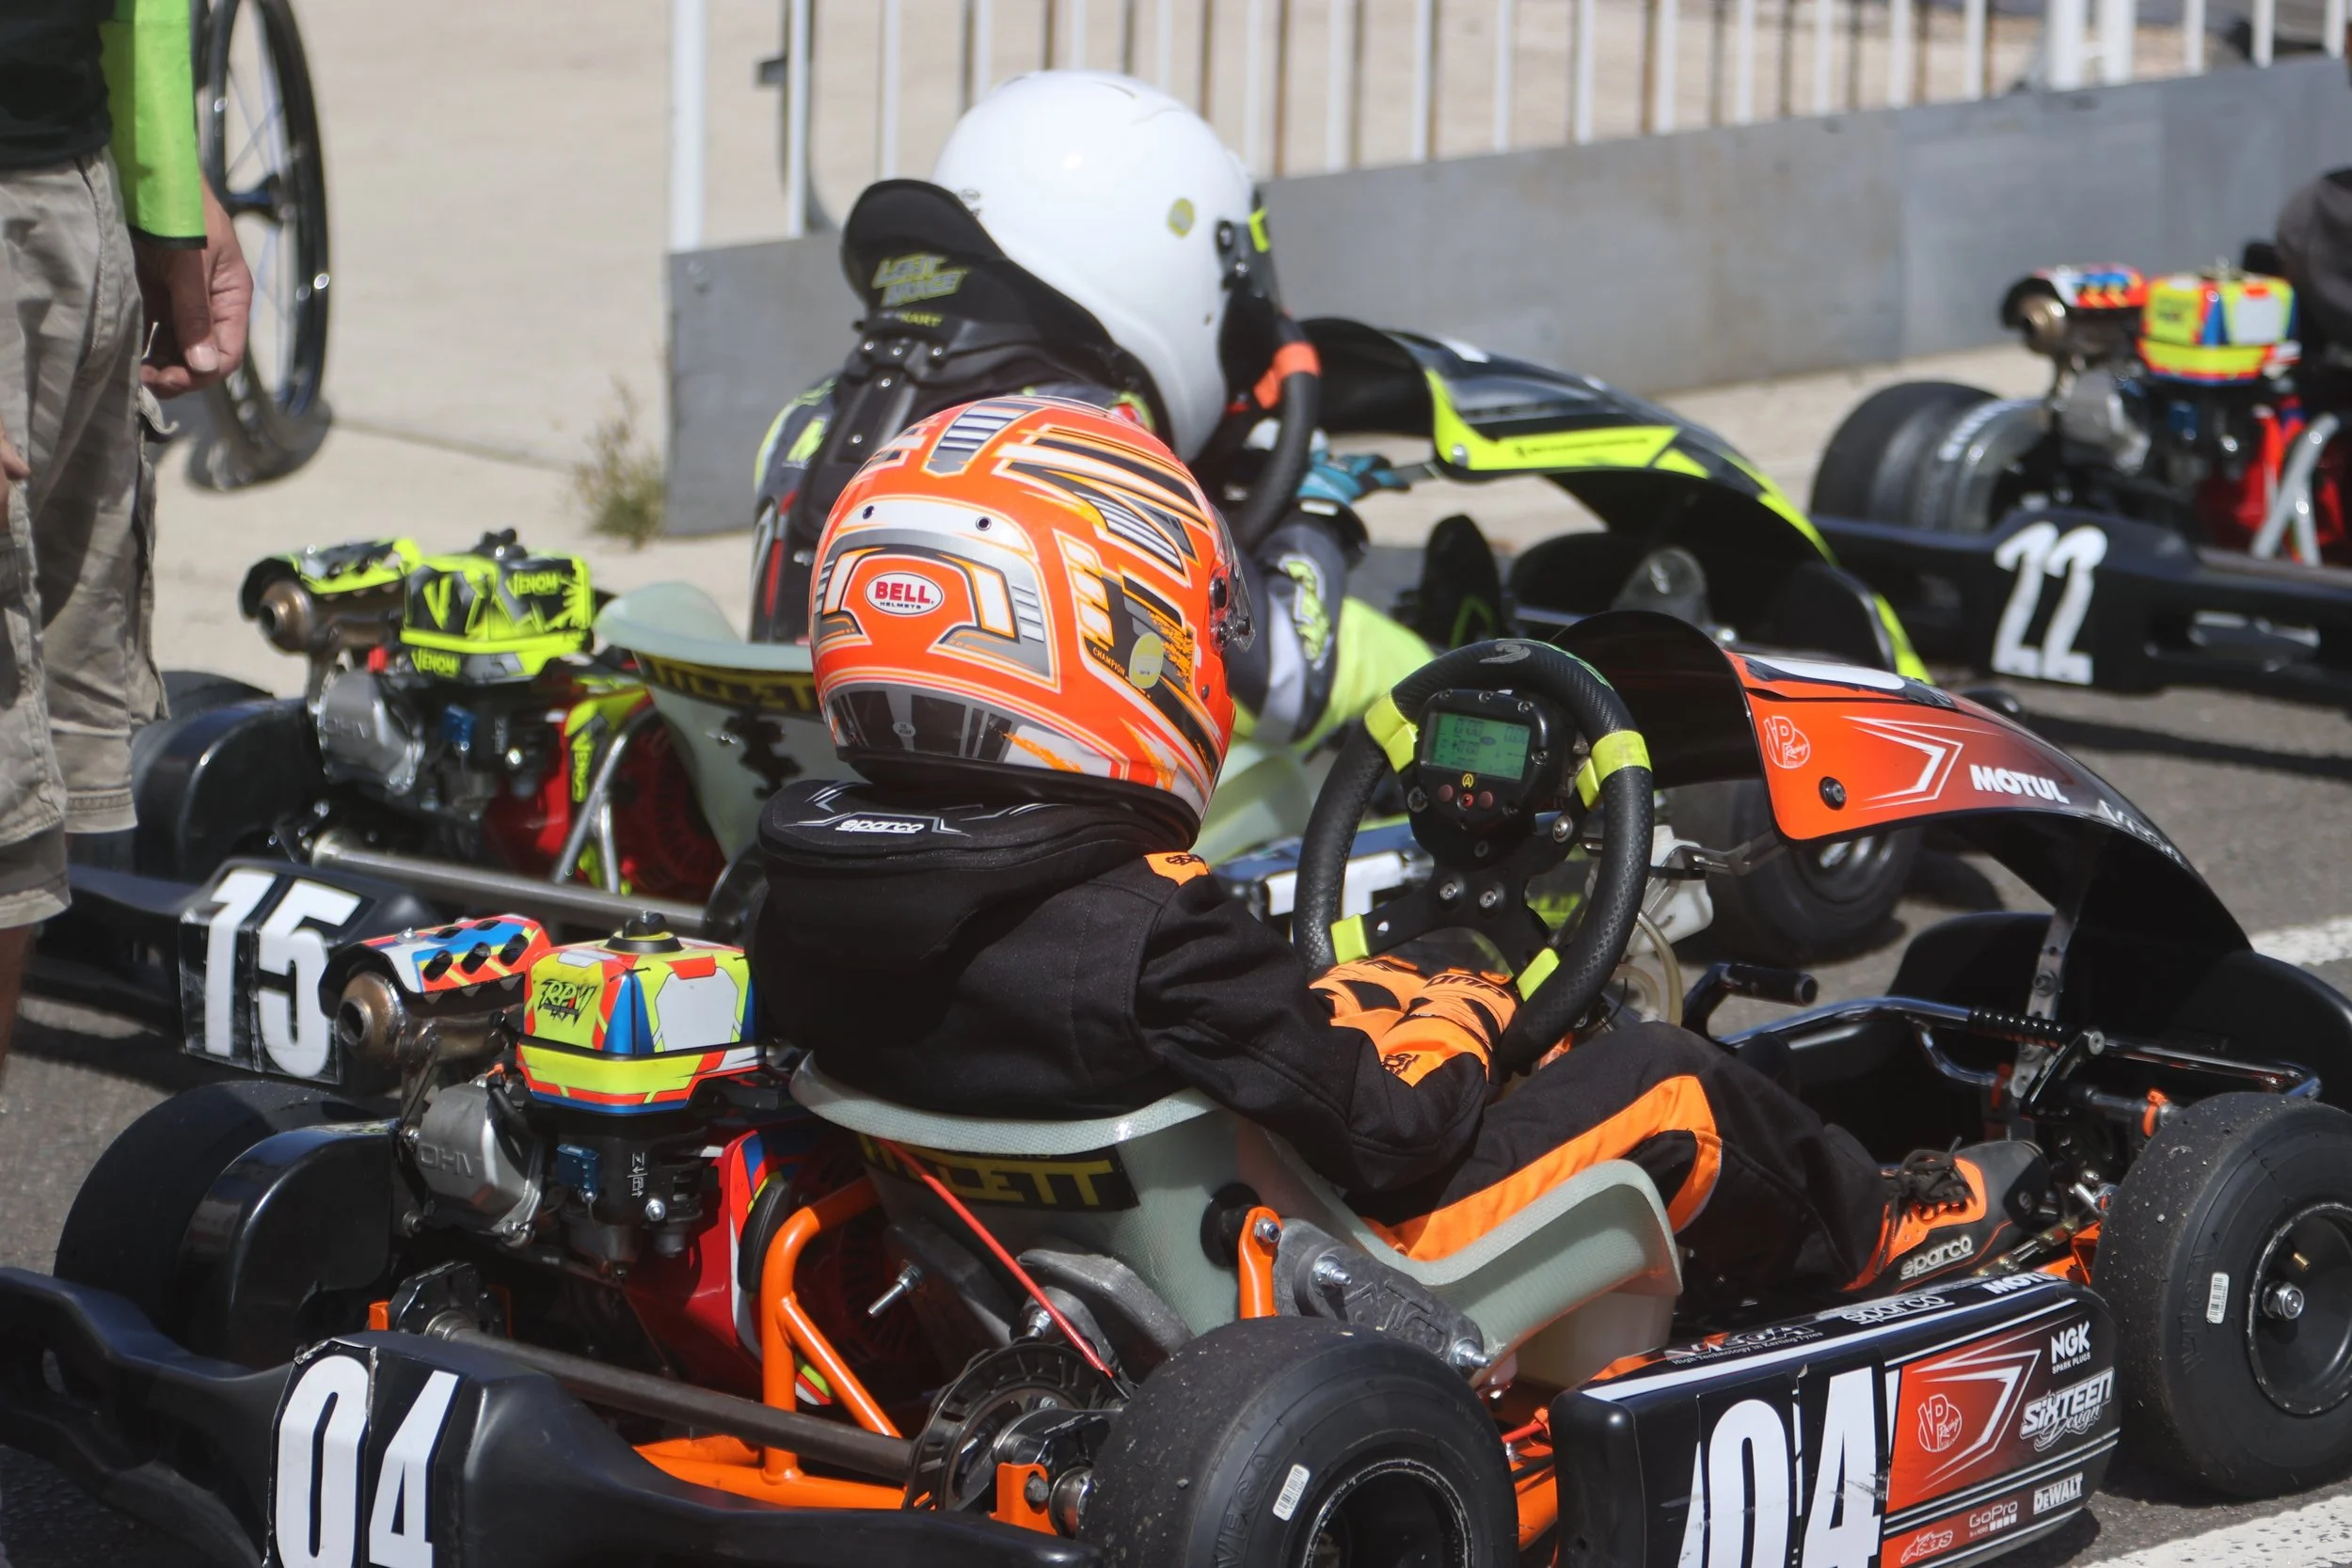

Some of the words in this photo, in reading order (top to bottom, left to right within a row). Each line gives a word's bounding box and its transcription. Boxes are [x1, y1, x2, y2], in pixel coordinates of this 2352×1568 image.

[505, 569, 562, 600] VENOM
[874, 580, 931, 605] BELL
[879, 600, 922, 610] HELMETS
[1991, 521, 2107, 686] 22
[410, 647, 460, 675] VENOM
[1091, 646, 1126, 677] CHAMPION
[1969, 764, 2070, 804] MOTUL
[836, 818, 924, 833] sparco
[204, 869, 361, 1079] 15
[1899, 1235, 1975, 1280] sparco
[1840, 1294, 1956, 1325] sparco
[2051, 1321, 2090, 1364] NGK
[2052, 1360, 2072, 1374] SPARK
[2072, 1352, 2090, 1369] PLUGS
[275, 1354, 436, 1568] 04
[1708, 1367, 1881, 1568] 04
[1969, 1500, 2018, 1528] GoPro
